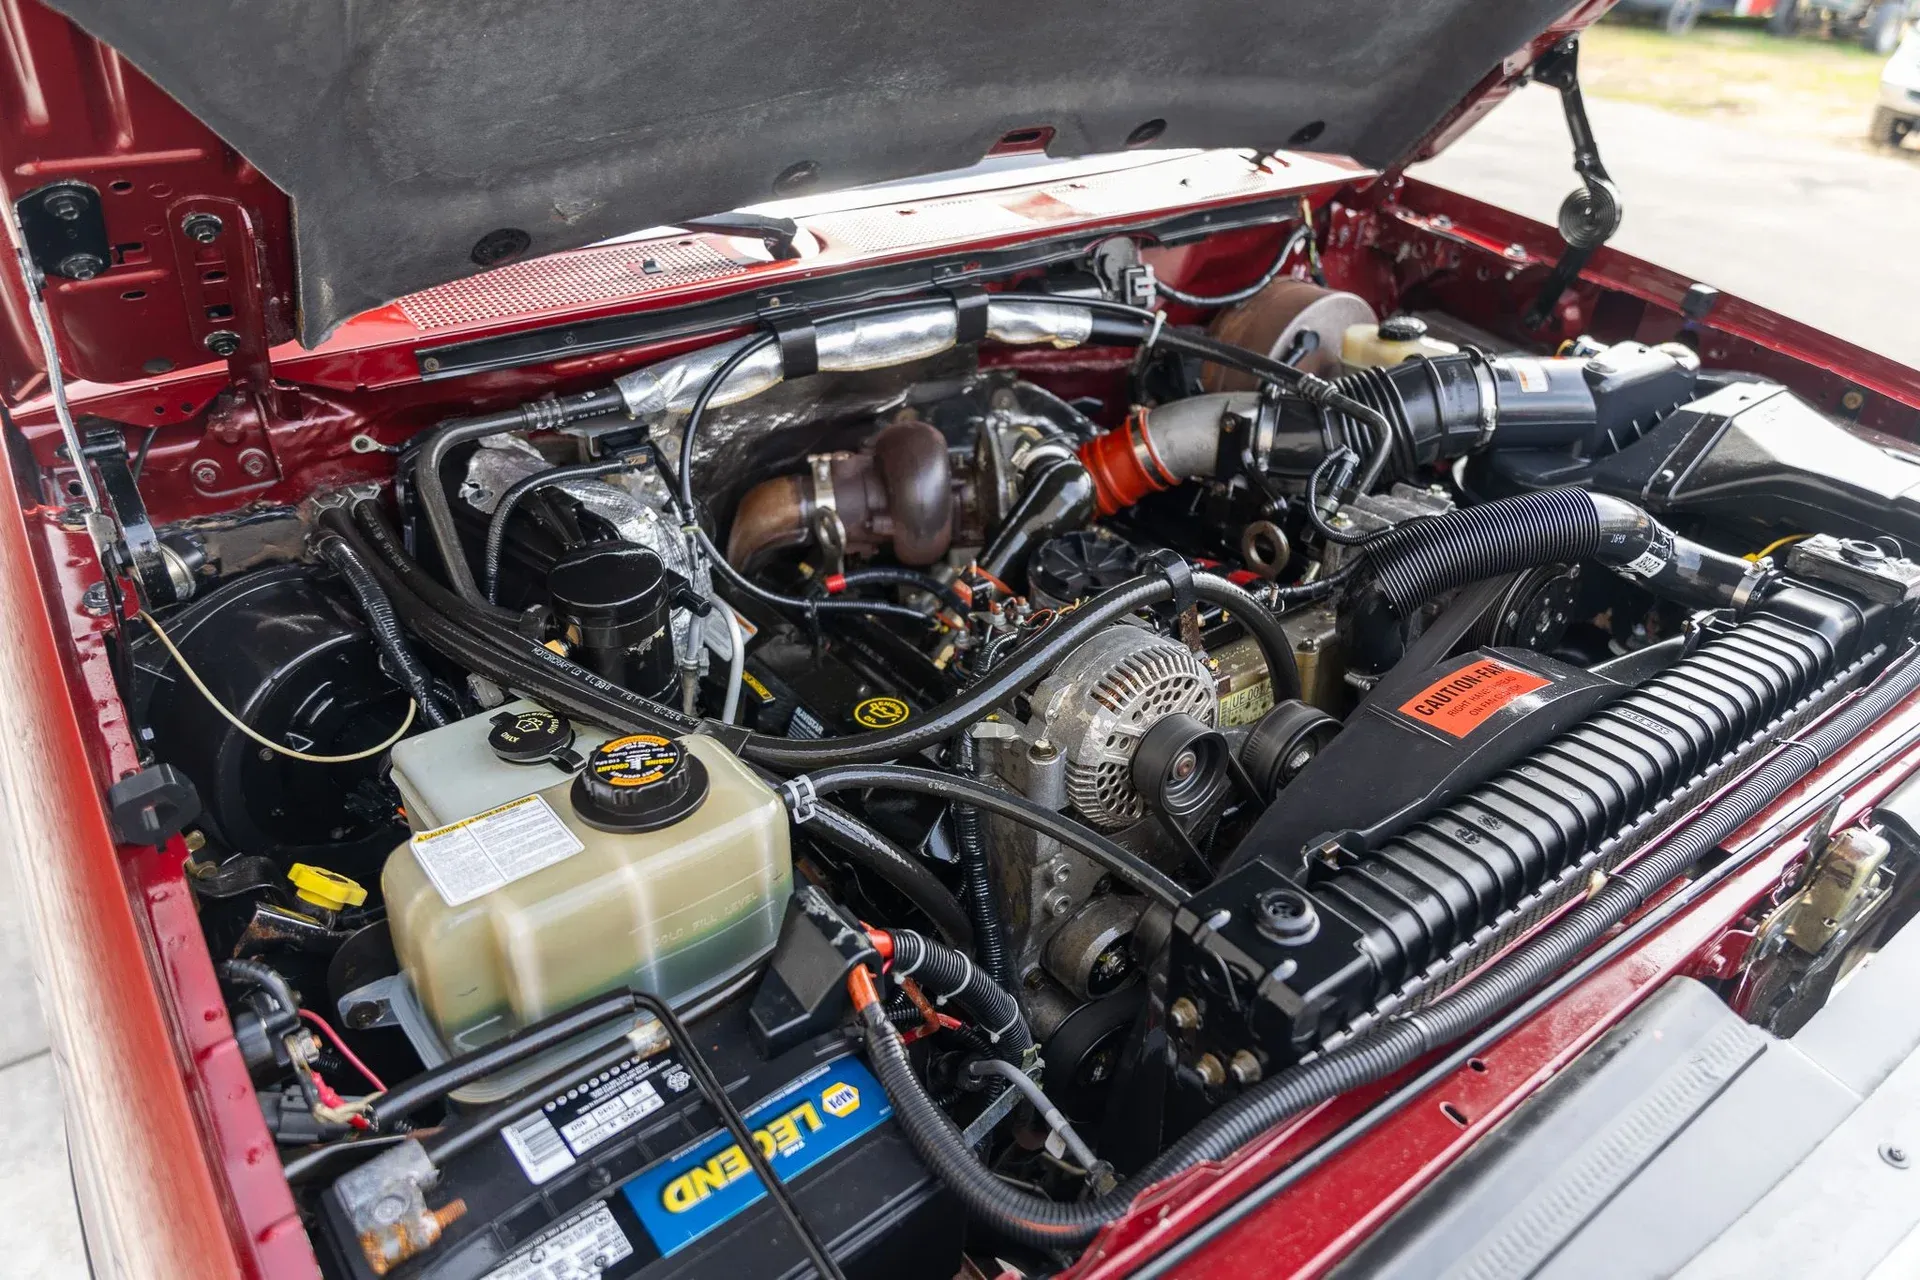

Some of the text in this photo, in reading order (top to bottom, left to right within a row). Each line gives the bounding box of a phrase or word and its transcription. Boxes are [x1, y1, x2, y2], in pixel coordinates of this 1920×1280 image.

[531, 647, 573, 671] MOTORCRAFT
[1447, 699, 1471, 717] RIGHT
[1469, 706, 1484, 716] ON
[795, 706, 824, 735] NAVISTAR
[863, 715, 877, 724] OIL
[500, 731, 520, 743] ONLY
[596, 757, 675, 773] ENGINE COOLANT
[425, 825, 459, 839] CAUTION
[828, 1085, 855, 1110] NAPA
